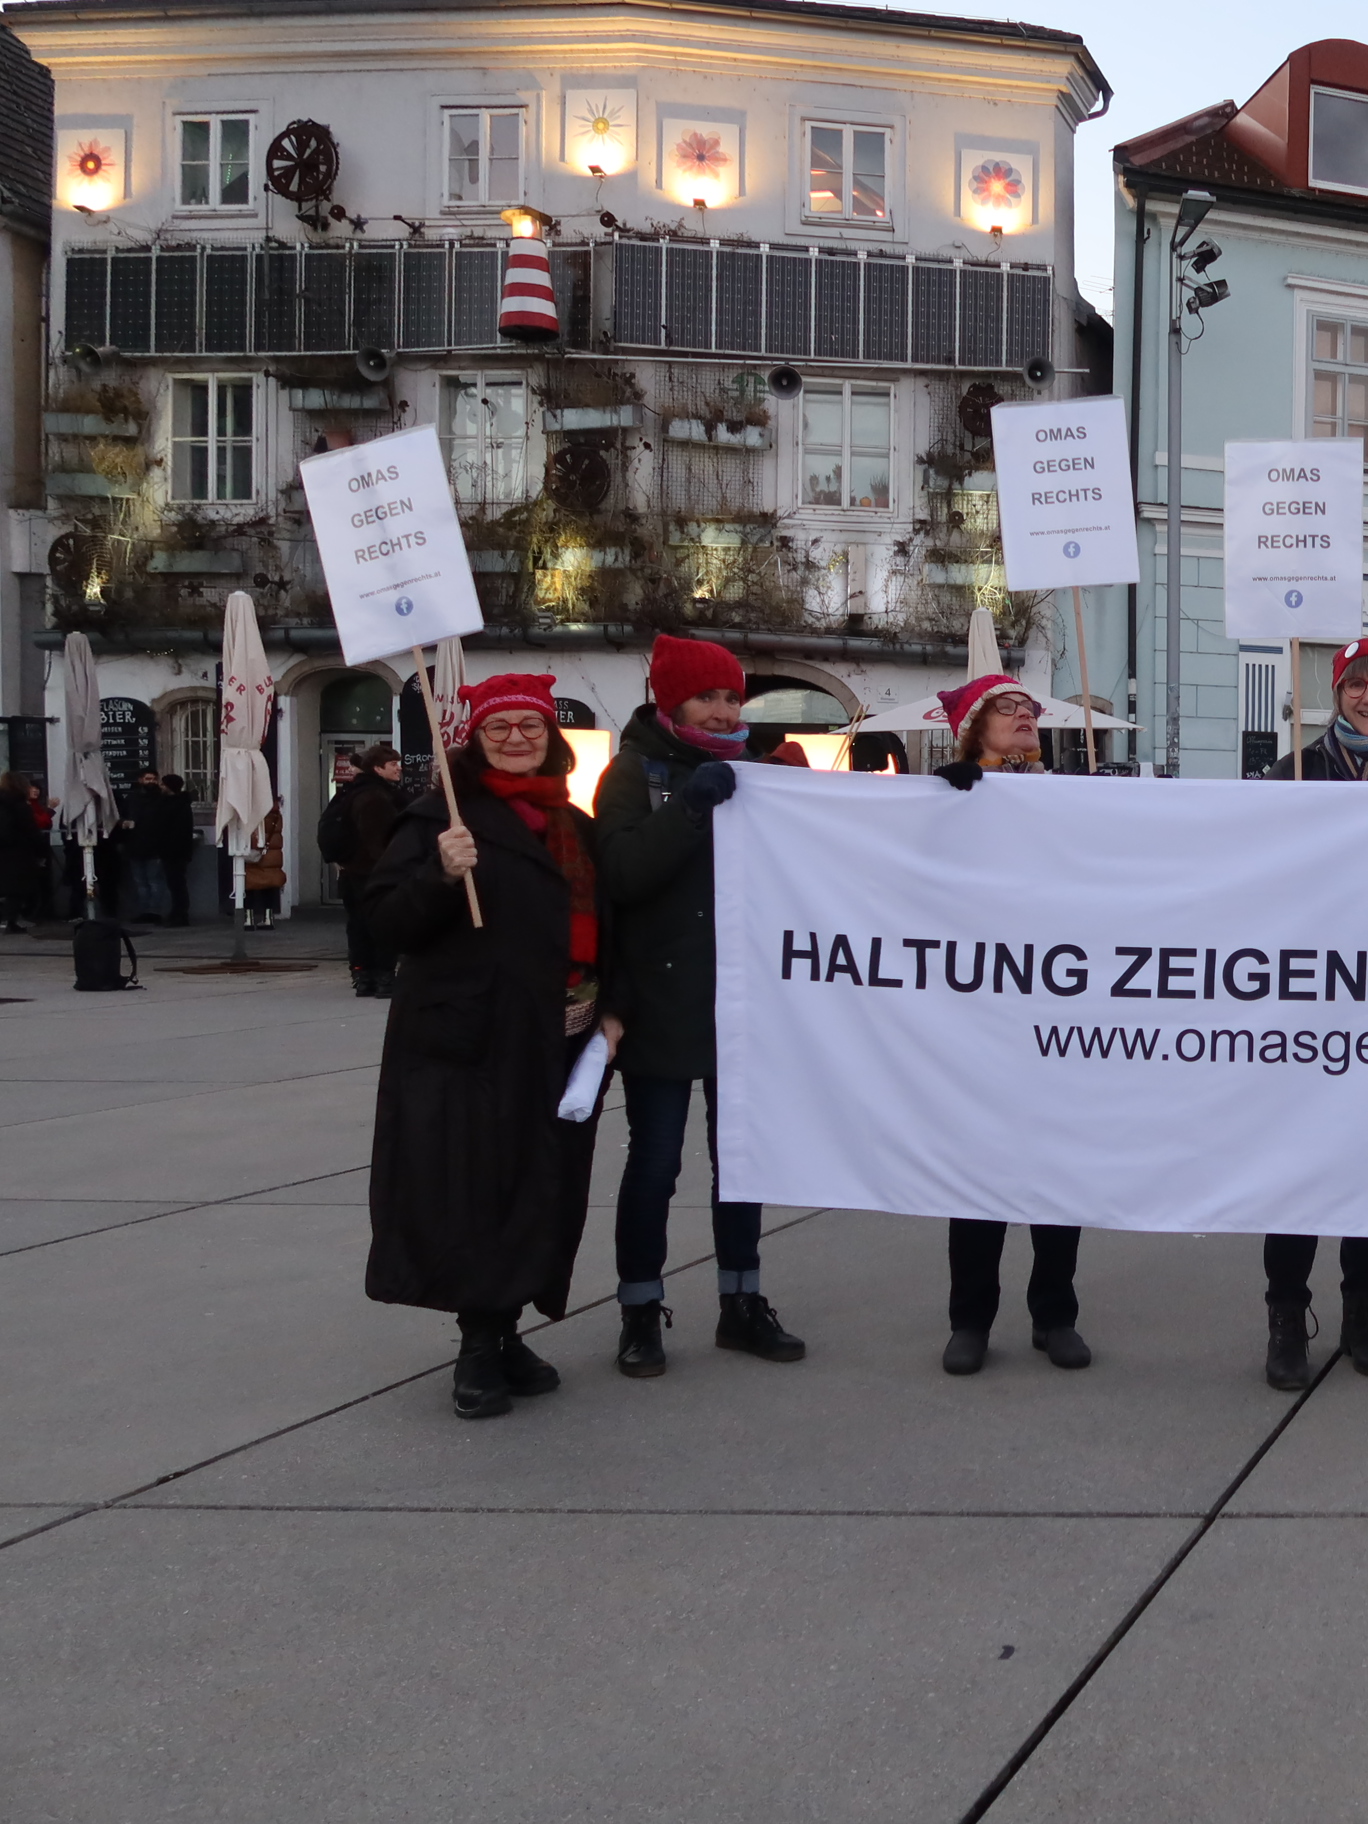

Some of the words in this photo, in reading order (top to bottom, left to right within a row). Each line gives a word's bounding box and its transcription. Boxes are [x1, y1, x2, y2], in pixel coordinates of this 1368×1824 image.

[1035, 426, 1087, 442] OMAS
[1033, 457, 1095, 474] GEGEN
[348, 465, 399, 492] OMAS
[1267, 468, 1321, 482] OMAS
[1031, 487, 1102, 506] RECHTS
[351, 498, 413, 528] GEGEN
[1262, 501, 1326, 516] GEGEN
[1029, 525, 1110, 536] www.omasgegenrechts.at
[354, 531, 427, 564] RECHTS
[1257, 534, 1331, 549] RECHTS
[359, 571, 441, 599] www.omasgegenrechts.at
[1252, 575, 1336, 583] www.omasgegenrechts.at
[885, 687, 891, 696] 4
[781, 929, 1089, 997] HALTUNG
